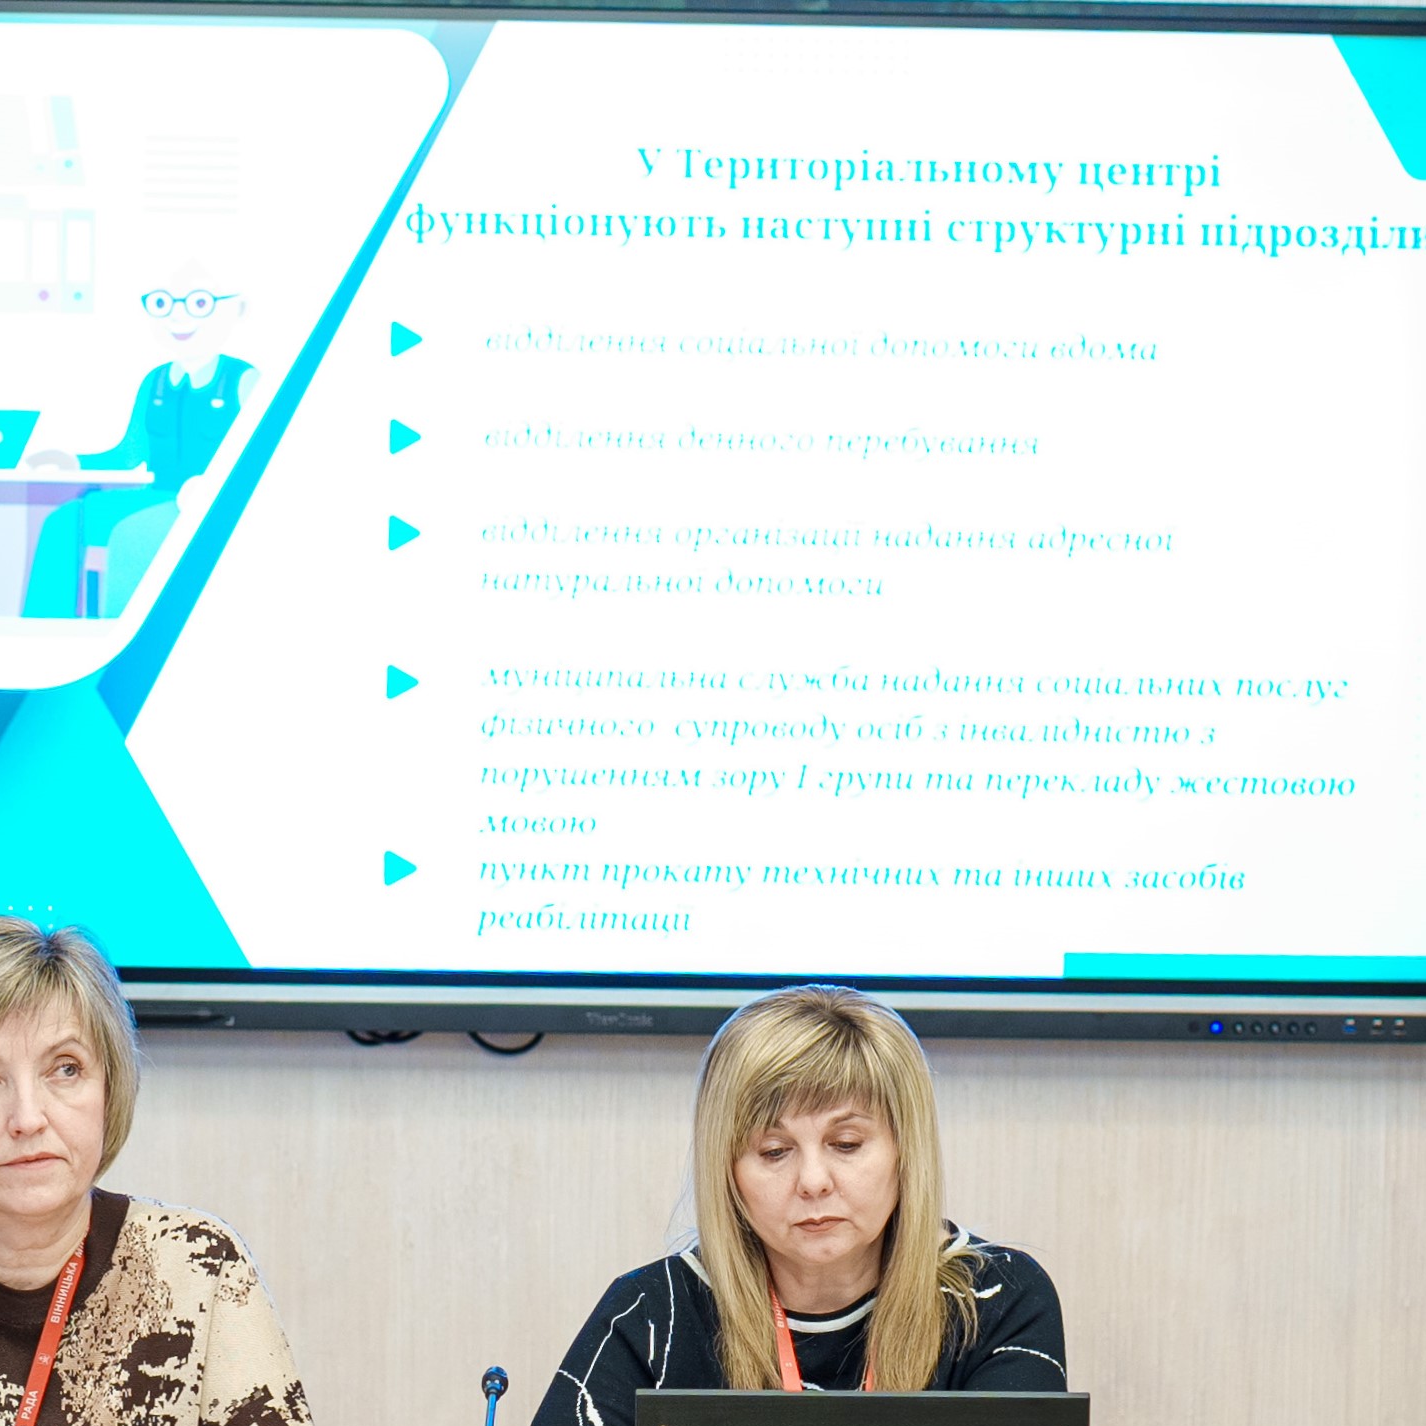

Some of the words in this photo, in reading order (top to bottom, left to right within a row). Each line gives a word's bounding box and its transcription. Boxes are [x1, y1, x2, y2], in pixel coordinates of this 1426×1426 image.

[636, 147, 662, 177] У
[675, 147, 1065, 195] Територіальному
[1078, 153, 1222, 198] центрі
[404, 199, 727, 247] функціонують
[741, 208, 932, 250] наступні
[946, 212, 1186, 256] структурні
[50, 1261, 79, 1324] ВІННИЦЬКА
[21, 1390, 39, 1420] РАДА
